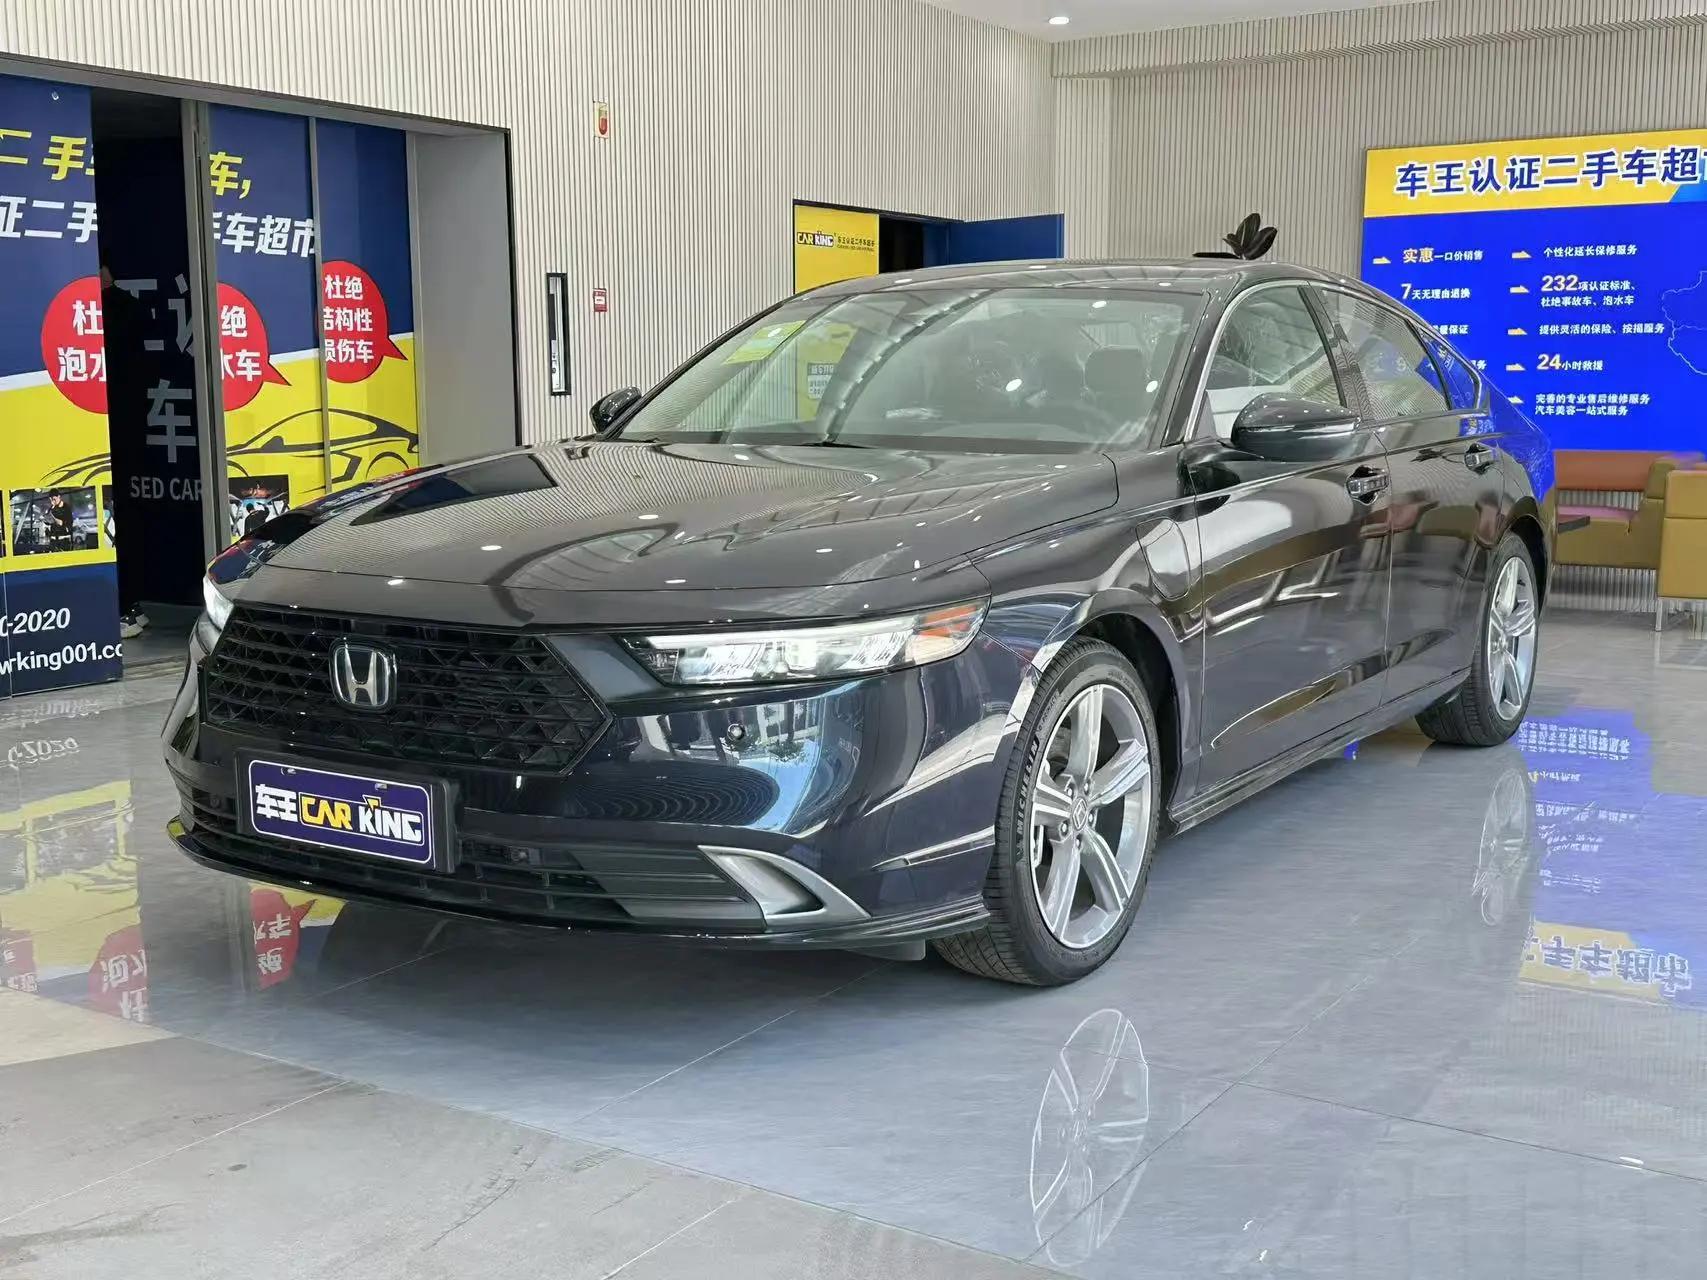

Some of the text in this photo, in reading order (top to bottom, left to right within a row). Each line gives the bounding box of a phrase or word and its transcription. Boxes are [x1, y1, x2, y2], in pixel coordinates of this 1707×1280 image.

[0, 128, 95, 180] 二手
[1395, 147, 1707, 198] 车王认证二手车超
[797, 231, 814, 245] CAR
[1543, 244, 1637, 258] 个性化延长保修服务
[1403, 247, 1483, 263] 实惠一口价销售
[324, 274, 364, 300] 杜绝
[220, 304, 248, 338] 绝
[1537, 353, 1604, 371] 24小时救援
[301, 794, 354, 831] CAR
[358, 804, 422, 842] KING
